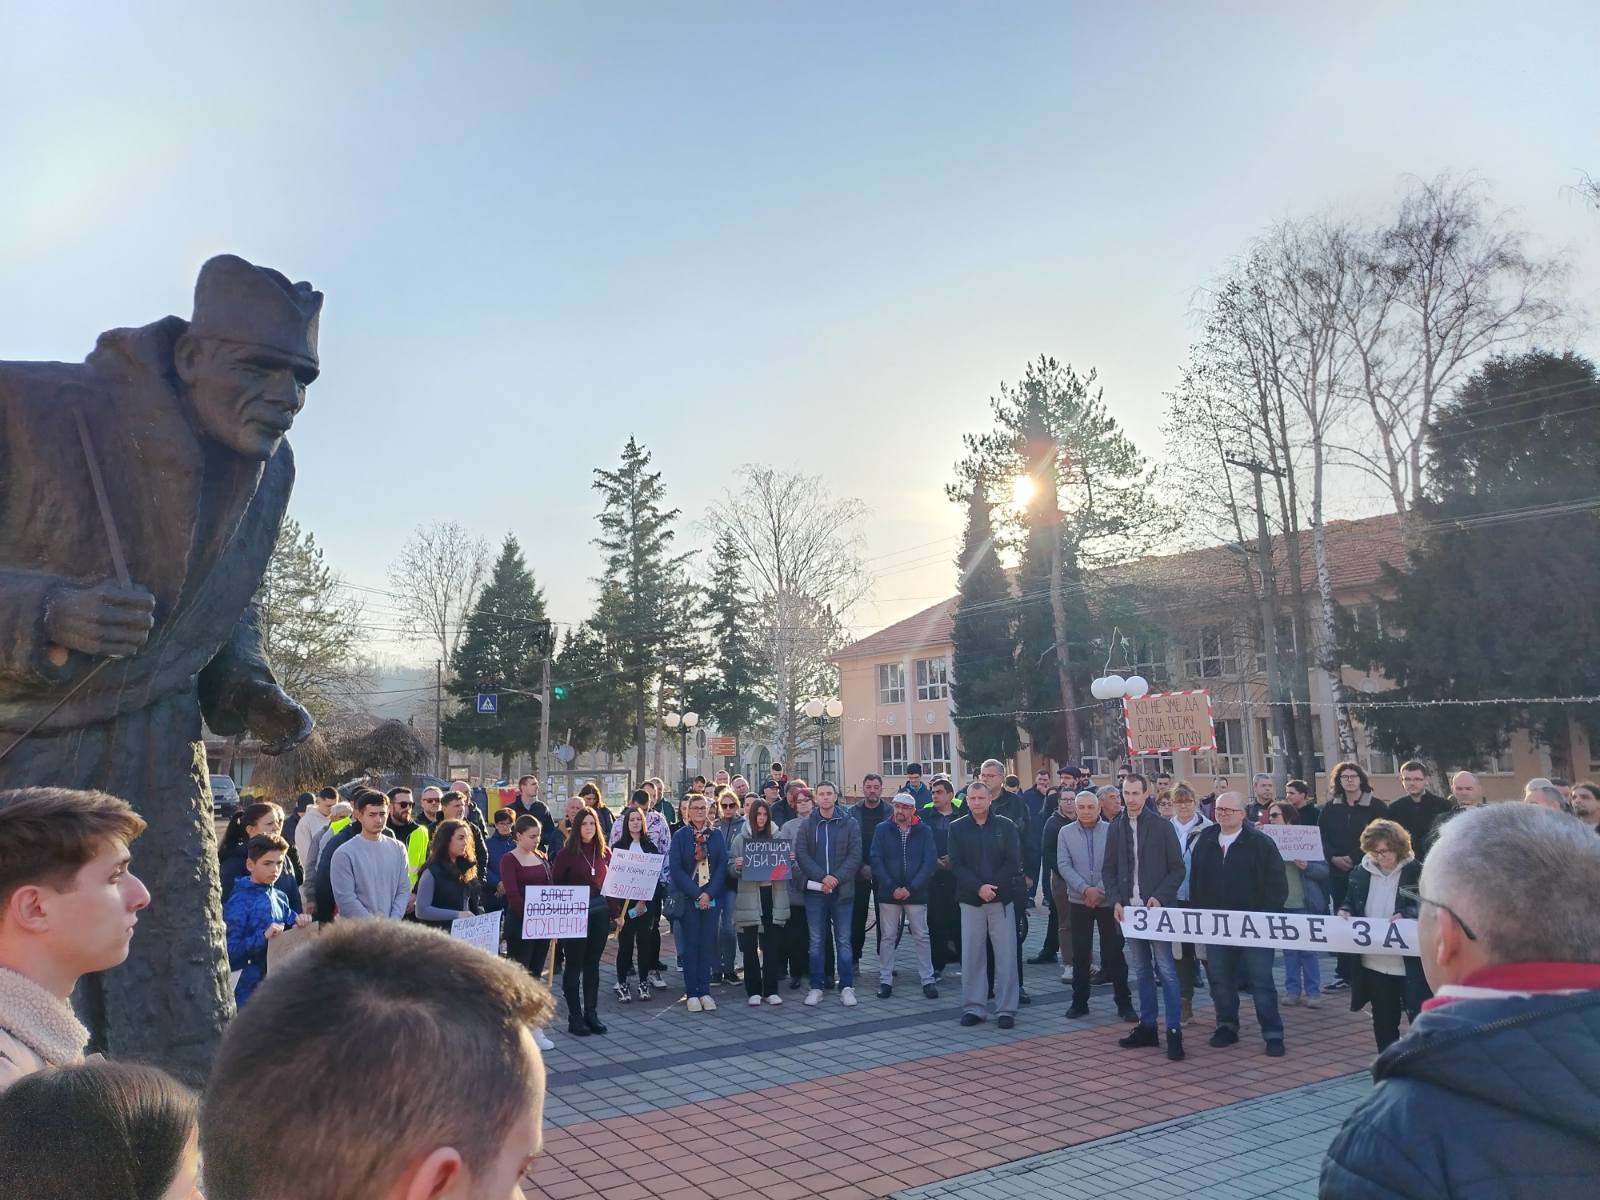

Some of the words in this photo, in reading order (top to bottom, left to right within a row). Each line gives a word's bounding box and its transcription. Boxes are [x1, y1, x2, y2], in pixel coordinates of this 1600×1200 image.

[1135, 700, 1148, 715] КО
[1150, 699, 1161, 714] НЕ
[1164, 698, 1182, 713] УМЕ
[1184, 697, 1200, 713] ДА
[1137, 716, 1166, 733] СЛУША
[745, 841, 791, 852] КОРУПЦИЈА
[745, 853, 787, 868] УБИЈА
[541, 889, 575, 902] ВЛАСТ
[526, 902, 587, 917] ОПОЗИЦИЈА
[525, 917, 588, 937] СТУДЕНТИ
[1133, 909, 1328, 944] ЗАПЛАЊЕ
[1352, 920, 1410, 950] ЗА
